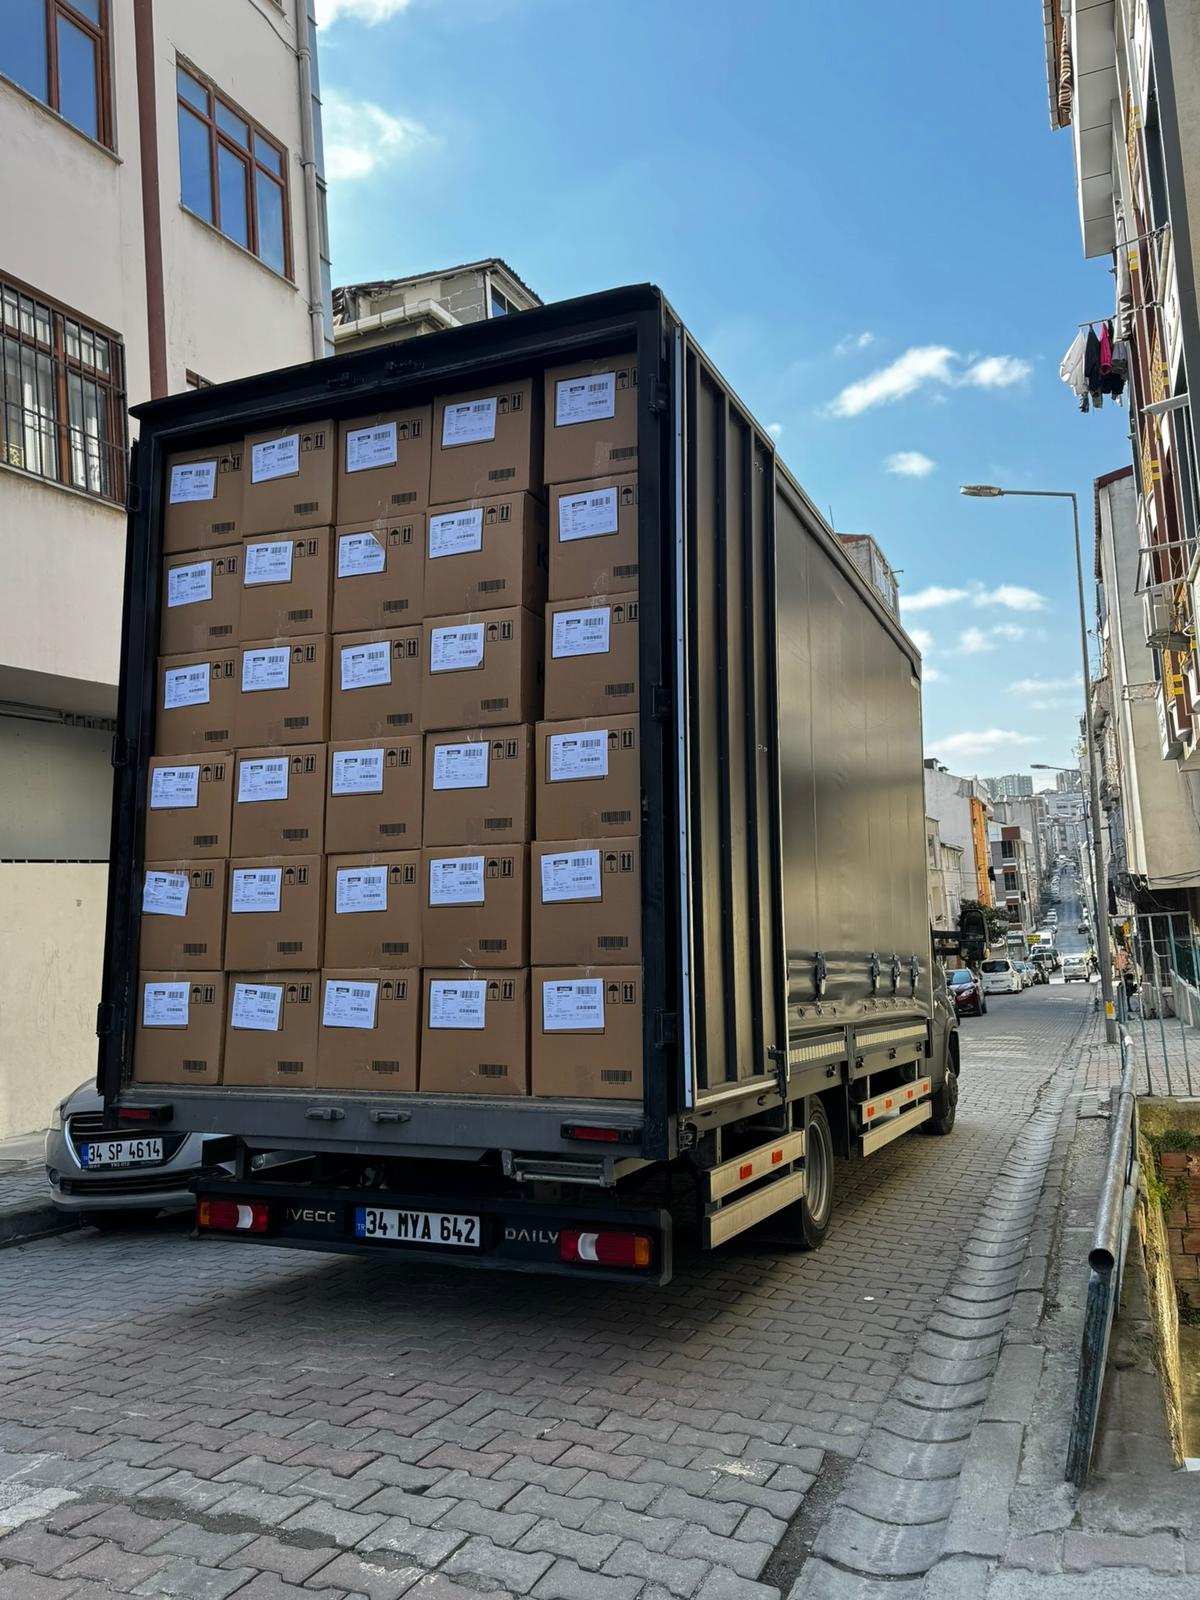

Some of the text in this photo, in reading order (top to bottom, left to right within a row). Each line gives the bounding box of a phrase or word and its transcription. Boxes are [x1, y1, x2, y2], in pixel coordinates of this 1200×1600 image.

[89, 1140, 160, 1161] 34 SP 4614
[366, 1210, 475, 1243] 34 MYA 642
[504, 1227, 559, 1244] DAILY
